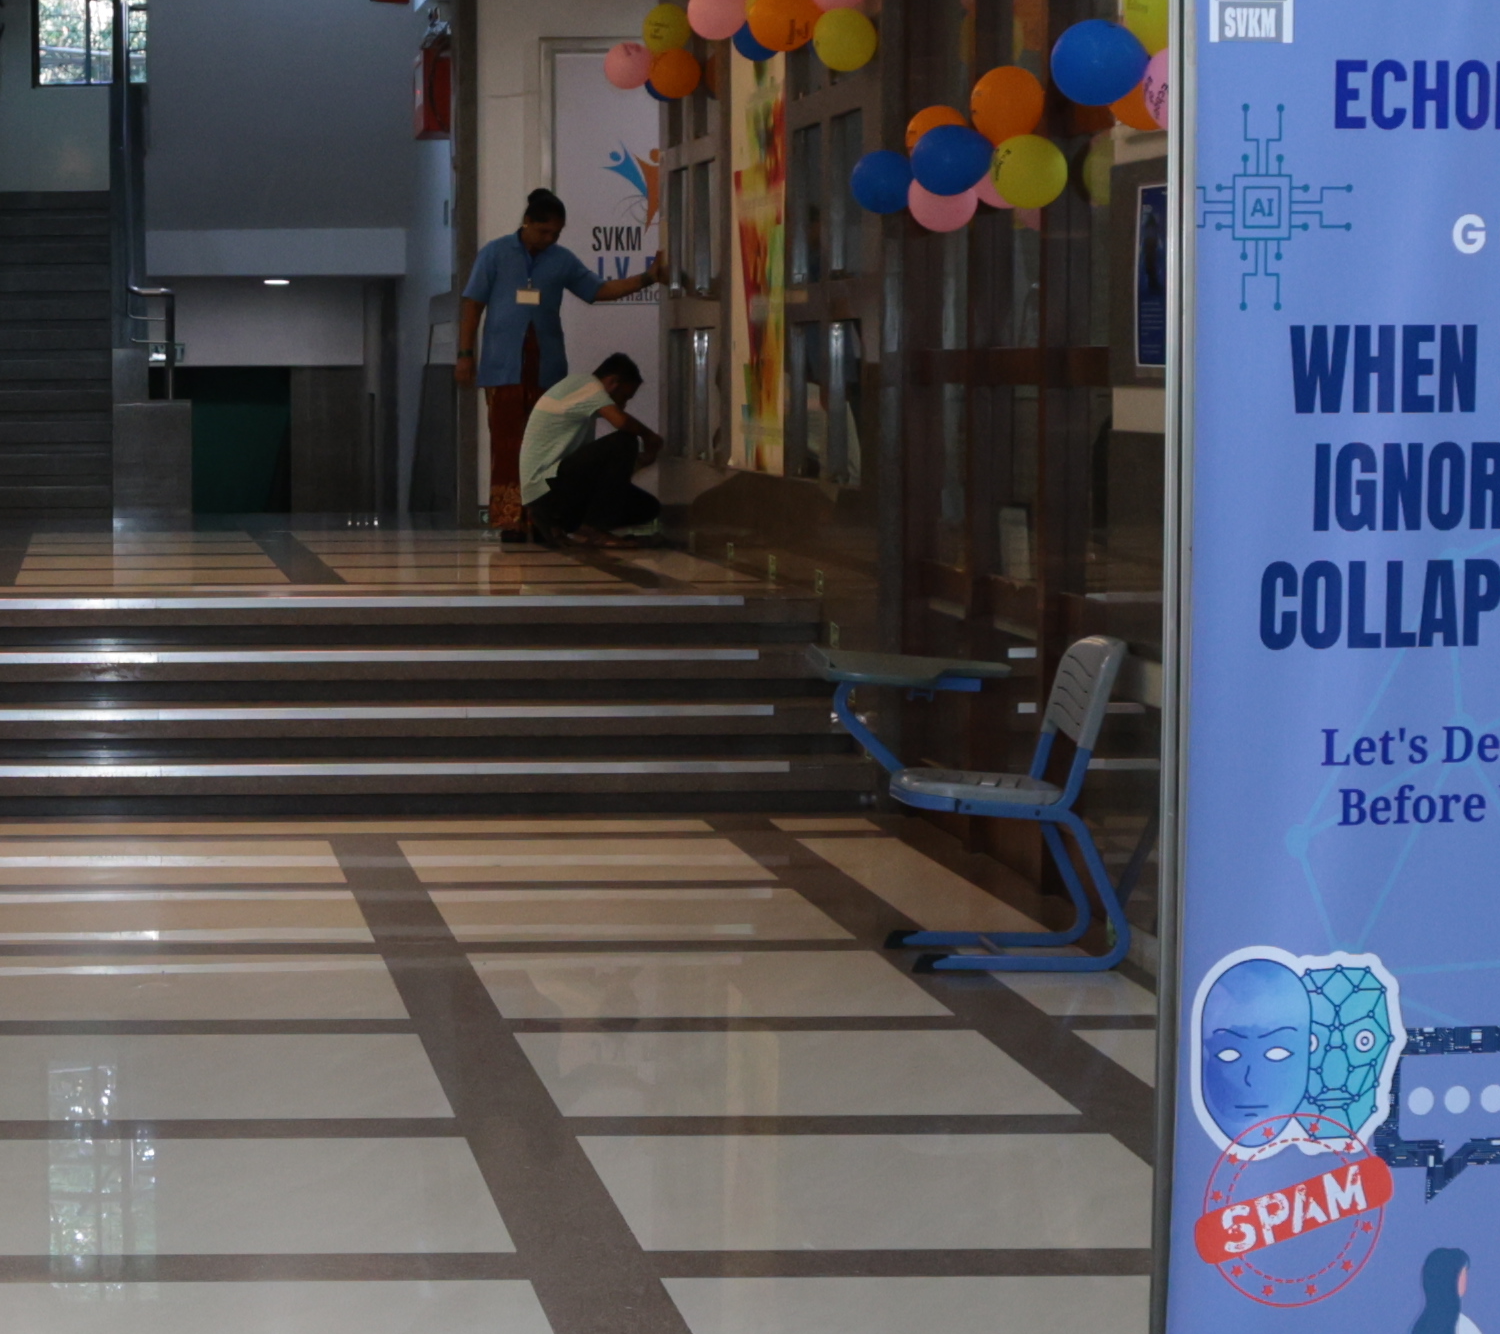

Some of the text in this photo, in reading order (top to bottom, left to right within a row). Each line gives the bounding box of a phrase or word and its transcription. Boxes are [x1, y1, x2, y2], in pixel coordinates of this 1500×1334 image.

[1224, 8, 1276, 38] SVKM
[1249, 197, 1274, 218] AI
[592, 226, 641, 252] SVKM
[1290, 324, 1478, 415] WHEN
[1321, 727, 1428, 768] Let's
[1337, 786, 1486, 827] Before
[1220, 1164, 1368, 1255] SPAM
